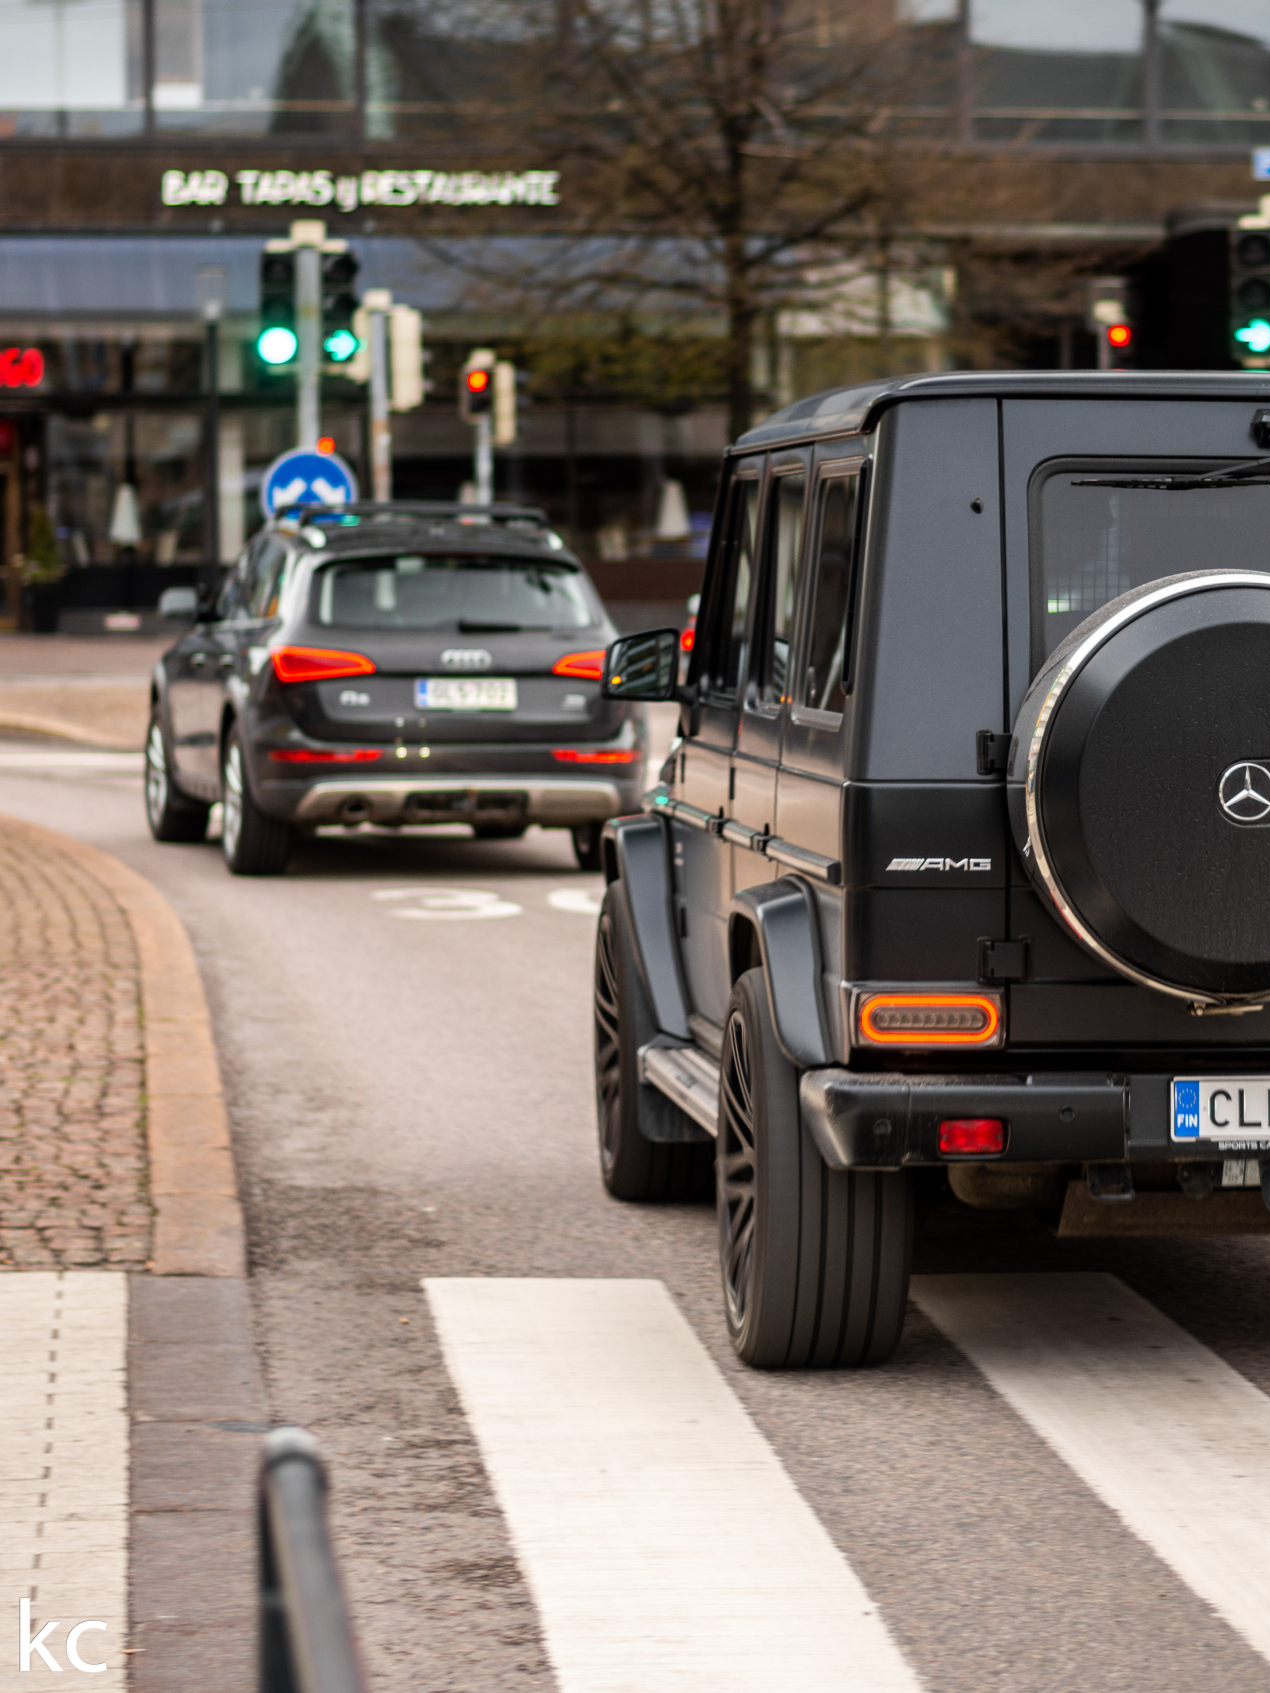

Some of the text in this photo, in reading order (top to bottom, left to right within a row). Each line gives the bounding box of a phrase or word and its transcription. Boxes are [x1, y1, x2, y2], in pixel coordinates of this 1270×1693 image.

[161, 169, 230, 206] BAR
[235, 169, 334, 206] TAPAS
[919, 857, 992, 872] AMG
[1177, 1113, 1199, 1128] FIN
